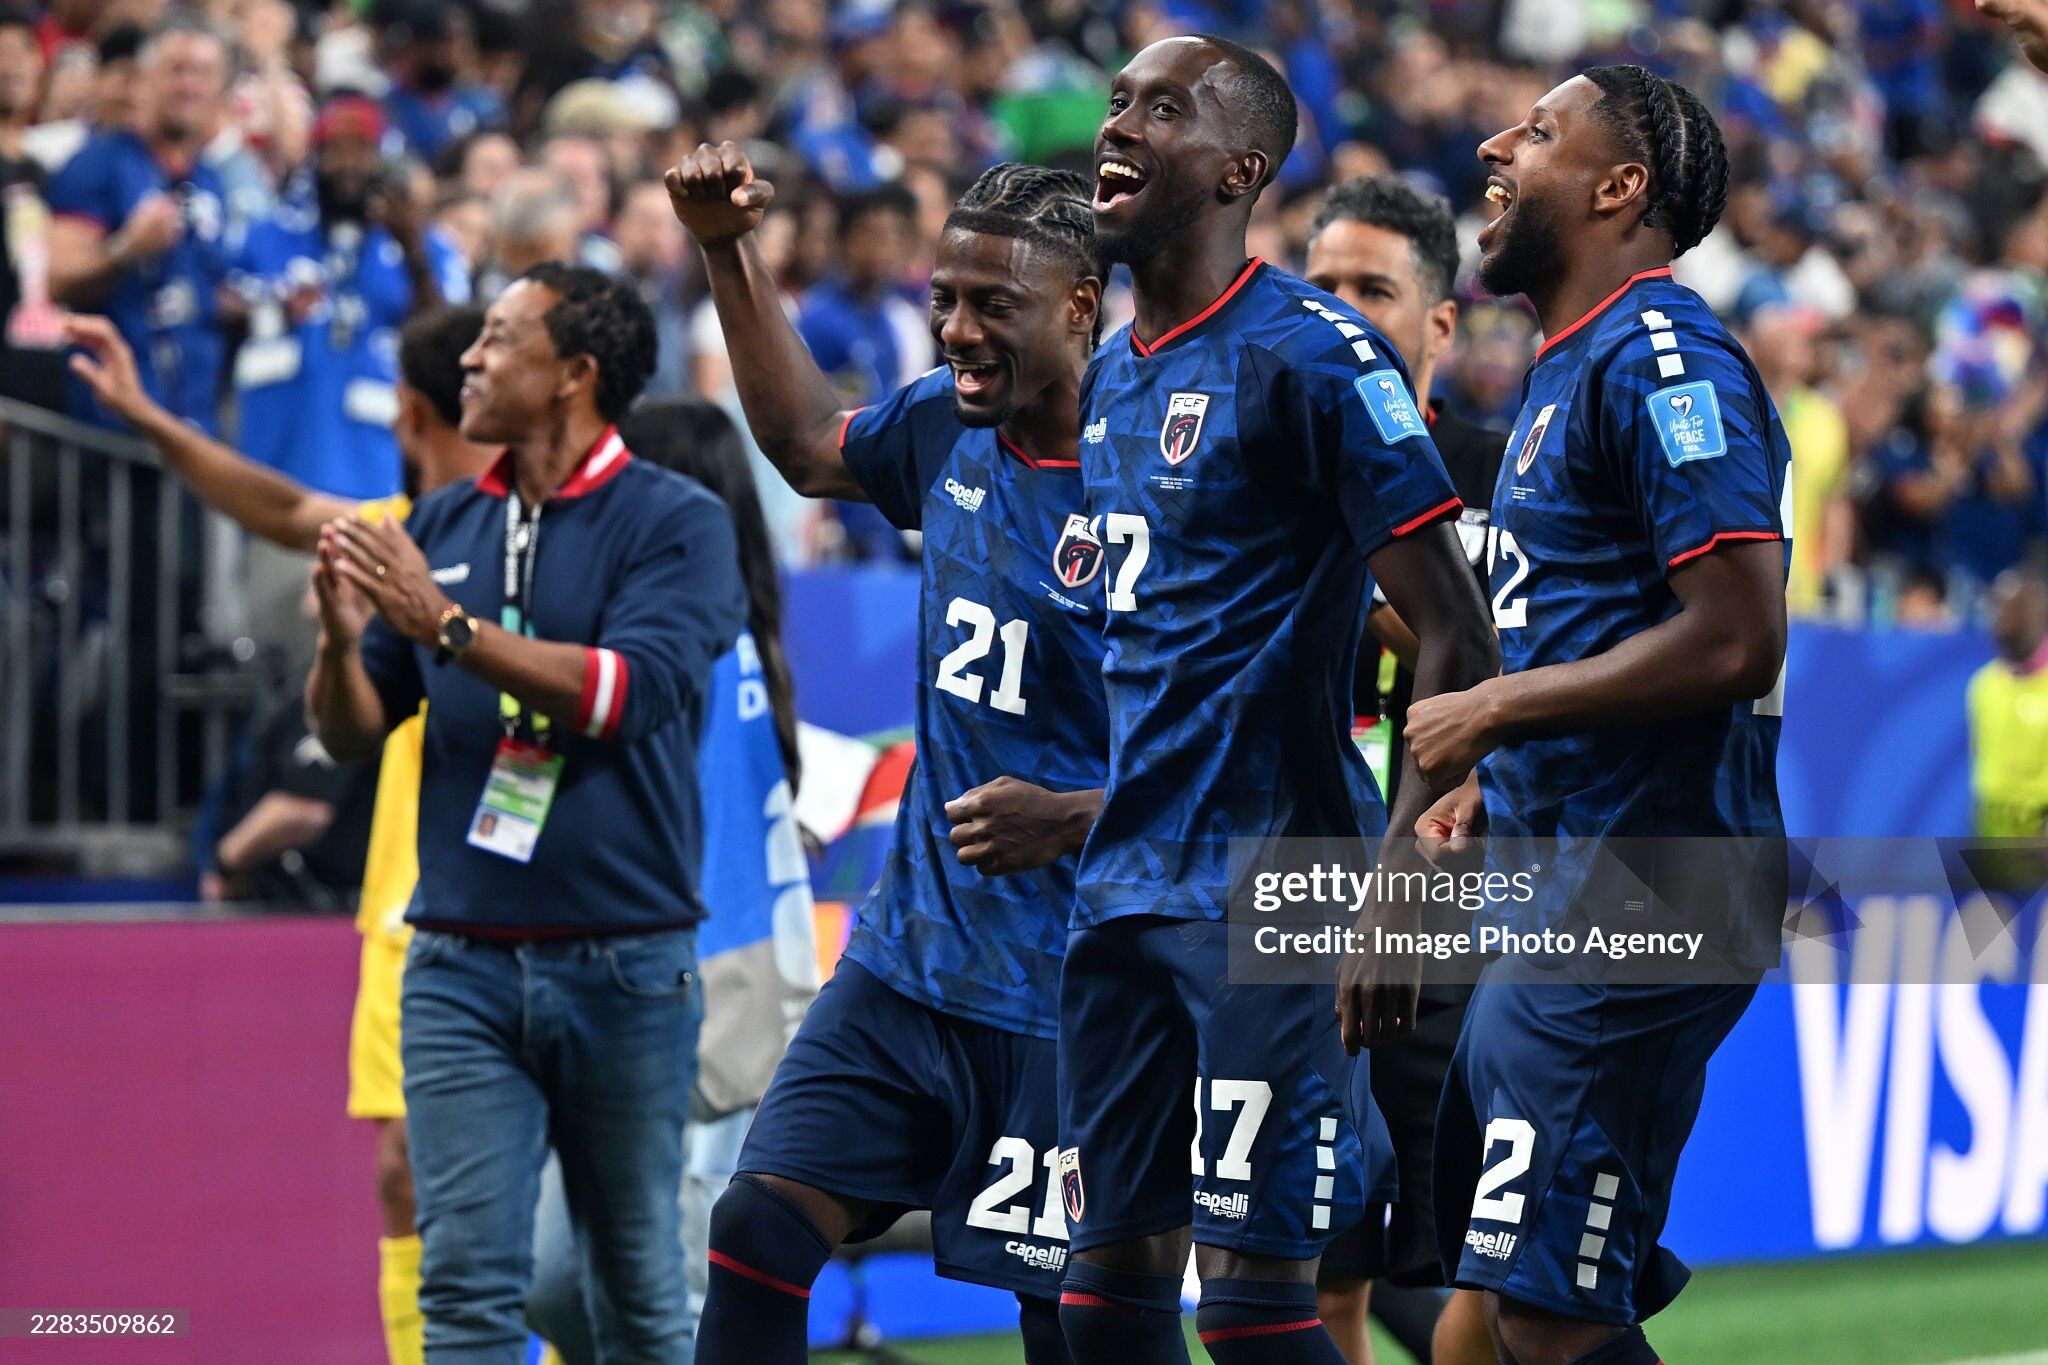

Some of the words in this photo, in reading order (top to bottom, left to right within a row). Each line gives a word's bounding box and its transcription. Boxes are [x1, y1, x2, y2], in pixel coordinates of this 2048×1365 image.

[1173, 397, 1205, 407] FCF
[1690, 415, 1705, 429] For
[1674, 429, 1706, 446] PEACE
[945, 478, 986, 508] capelli
[1070, 519, 1090, 532] FC
[1487, 526, 1529, 628] 2
[935, 597, 1028, 715] 21
[966, 1136, 1070, 1240] 21
[1193, 1190, 1249, 1213] capelli
[1213, 1208, 1247, 1220] SPORT
[1465, 1230, 1517, 1254] apelli
[1005, 1240, 1067, 1265] capelli
[1475, 1246, 1510, 1260] SPORT
[1028, 1260, 1063, 1272] SPORT
